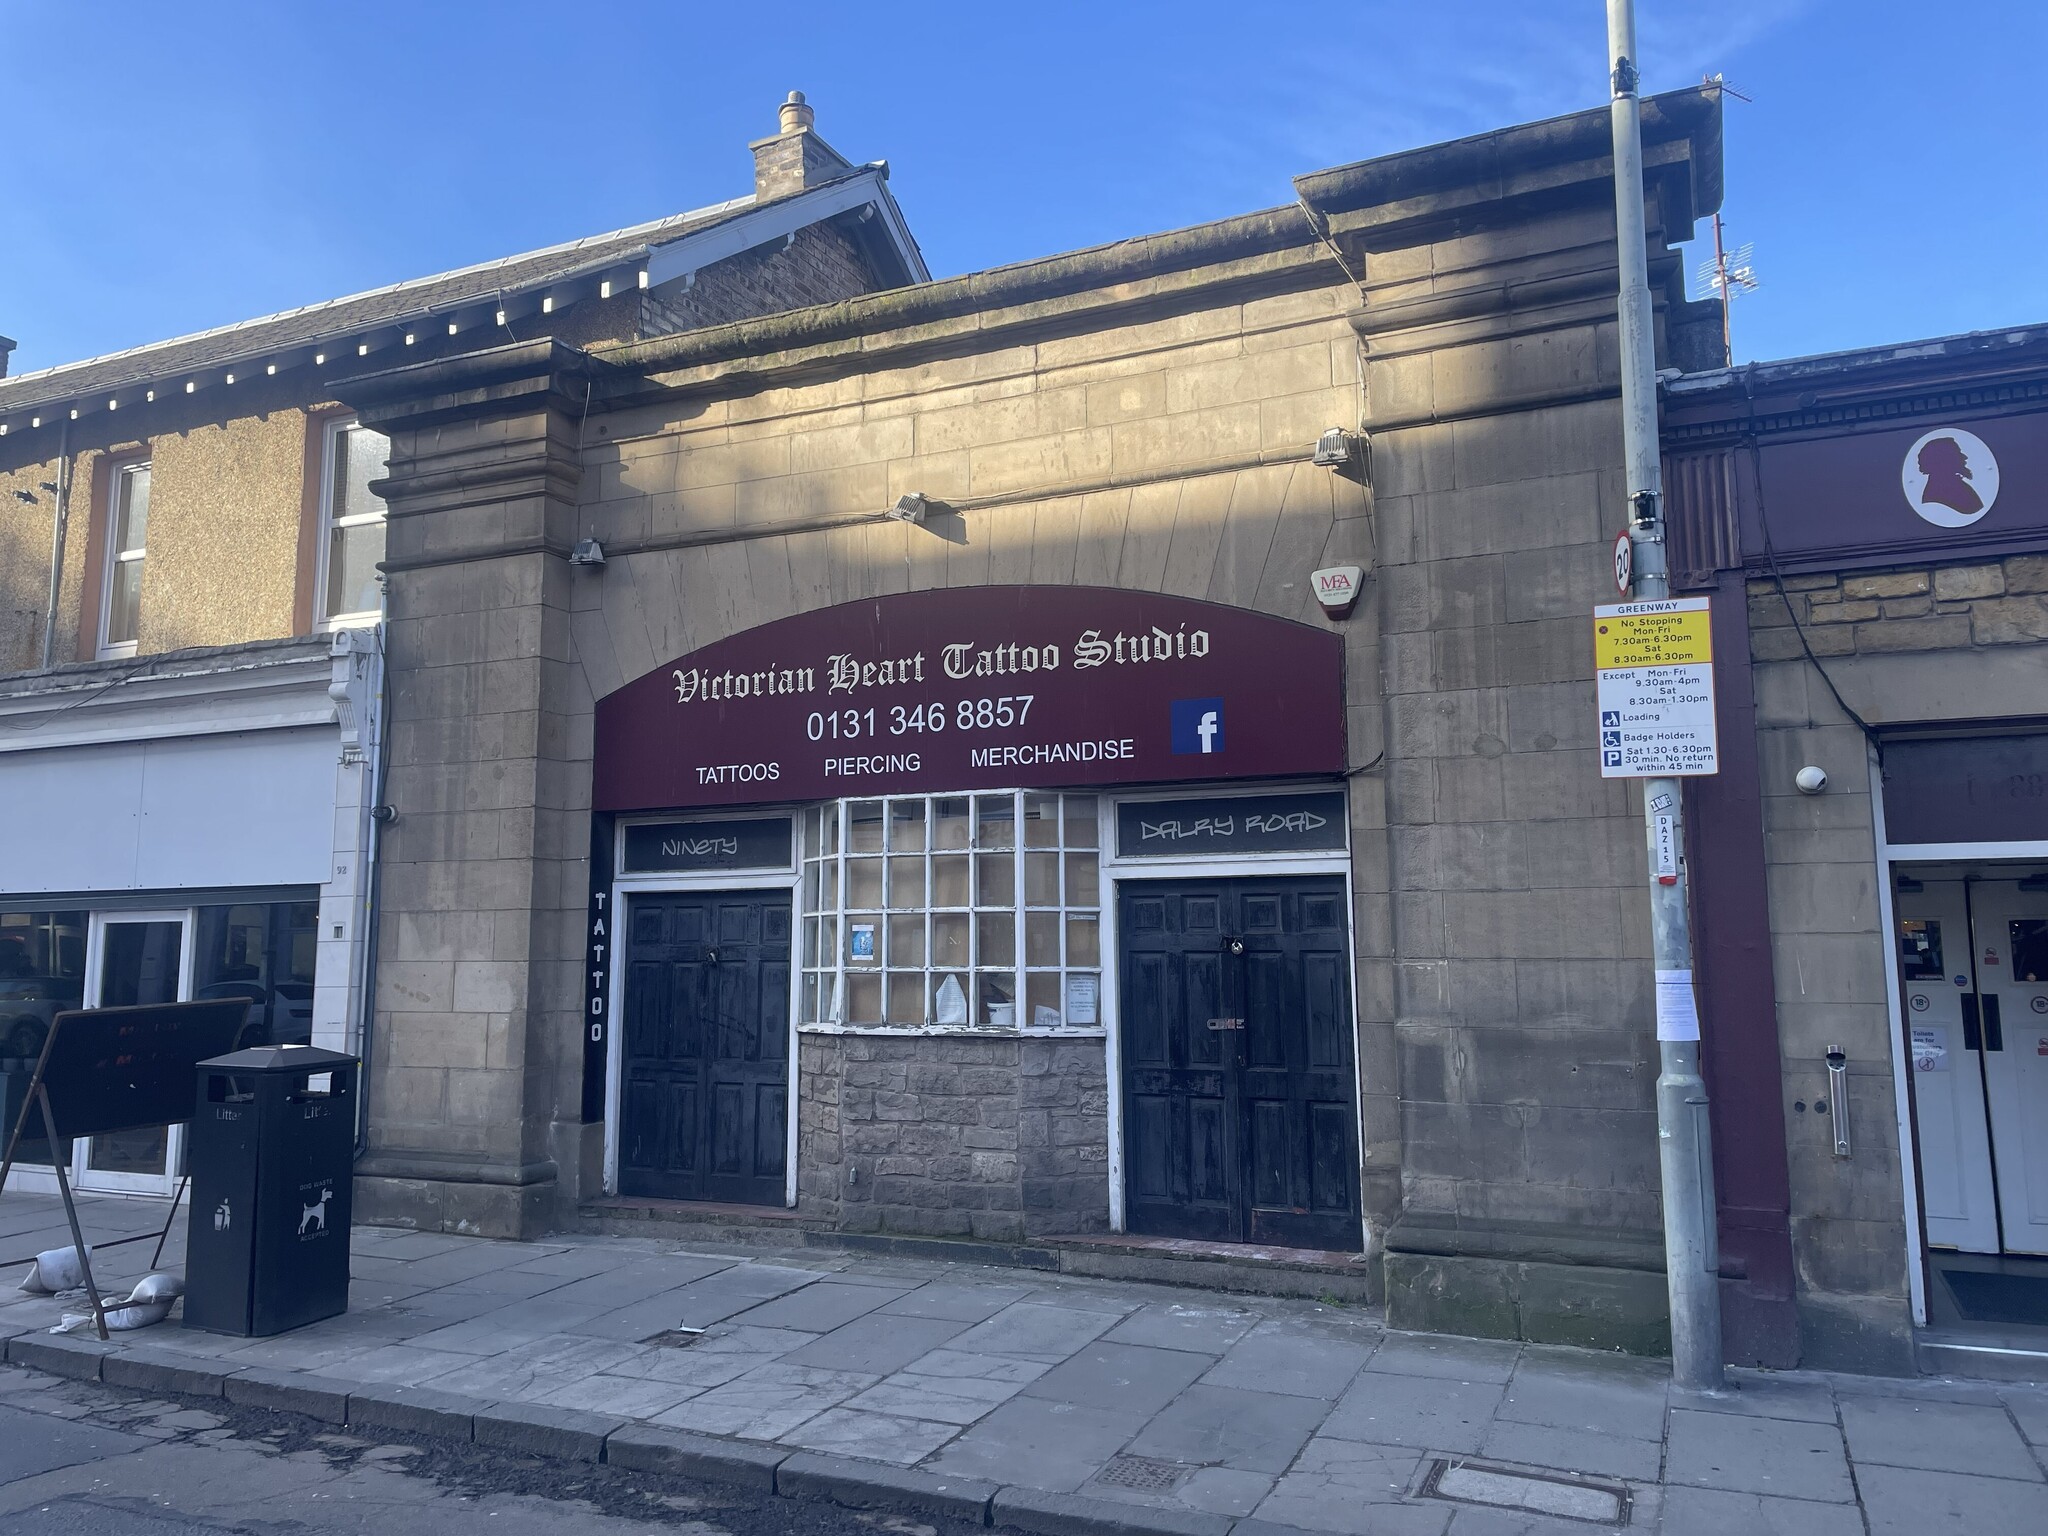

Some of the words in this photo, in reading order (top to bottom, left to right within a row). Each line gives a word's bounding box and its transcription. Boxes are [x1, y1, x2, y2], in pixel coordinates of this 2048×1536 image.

[1617, 548, 1628, 580] 20
[1320, 574, 1351, 589] MFA
[1618, 602, 1678, 614] GREENWAY
[1639, 617, 1682, 627] Stopping
[1634, 626, 1671, 635] Mon-Fri
[1614, 635, 1692, 645] 7.30am-6.30pm
[672, 661, 816, 704] Victorian
[827, 650, 926, 697] Heart
[941, 640, 1060, 681] Tattoo
[1073, 622, 1211, 669] Studio
[1614, 652, 1693, 663] 8.30am-6.30pm
[1603, 672, 1636, 681] Except
[1648, 668, 1687, 677] Mon-Fri
[1636, 677, 1700, 687] 9.30am-4pm
[1629, 695, 1708, 705] 8.30am-1.30pm
[806, 707, 876, 742] 0131
[889, 700, 946, 735] 346
[956, 694, 1035, 731] 8857
[1623, 713, 1660, 721] Loading
[1624, 733, 1653, 742] Badge
[1658, 732, 1695, 740] Holders
[1627, 747, 1643, 755] Sat
[1647, 745, 1711, 754] 1.30-6.30pm
[696, 761, 780, 784] TATTOOS
[824, 752, 921, 777] PIERCING
[970, 738, 1135, 768] MERCHANDISE
[1682, 753, 1714, 761] return
[1140, 814, 1234, 841] DALRY
[1245, 811, 1327, 833] ROAD
[336, 866, 347, 875] 92
[591, 891, 606, 1042] TATTOO
[299, 1181, 312, 1191] DOG
[313, 1177, 334, 1188] WASTE
[299, 1230, 330, 1242] ACCEPTED
